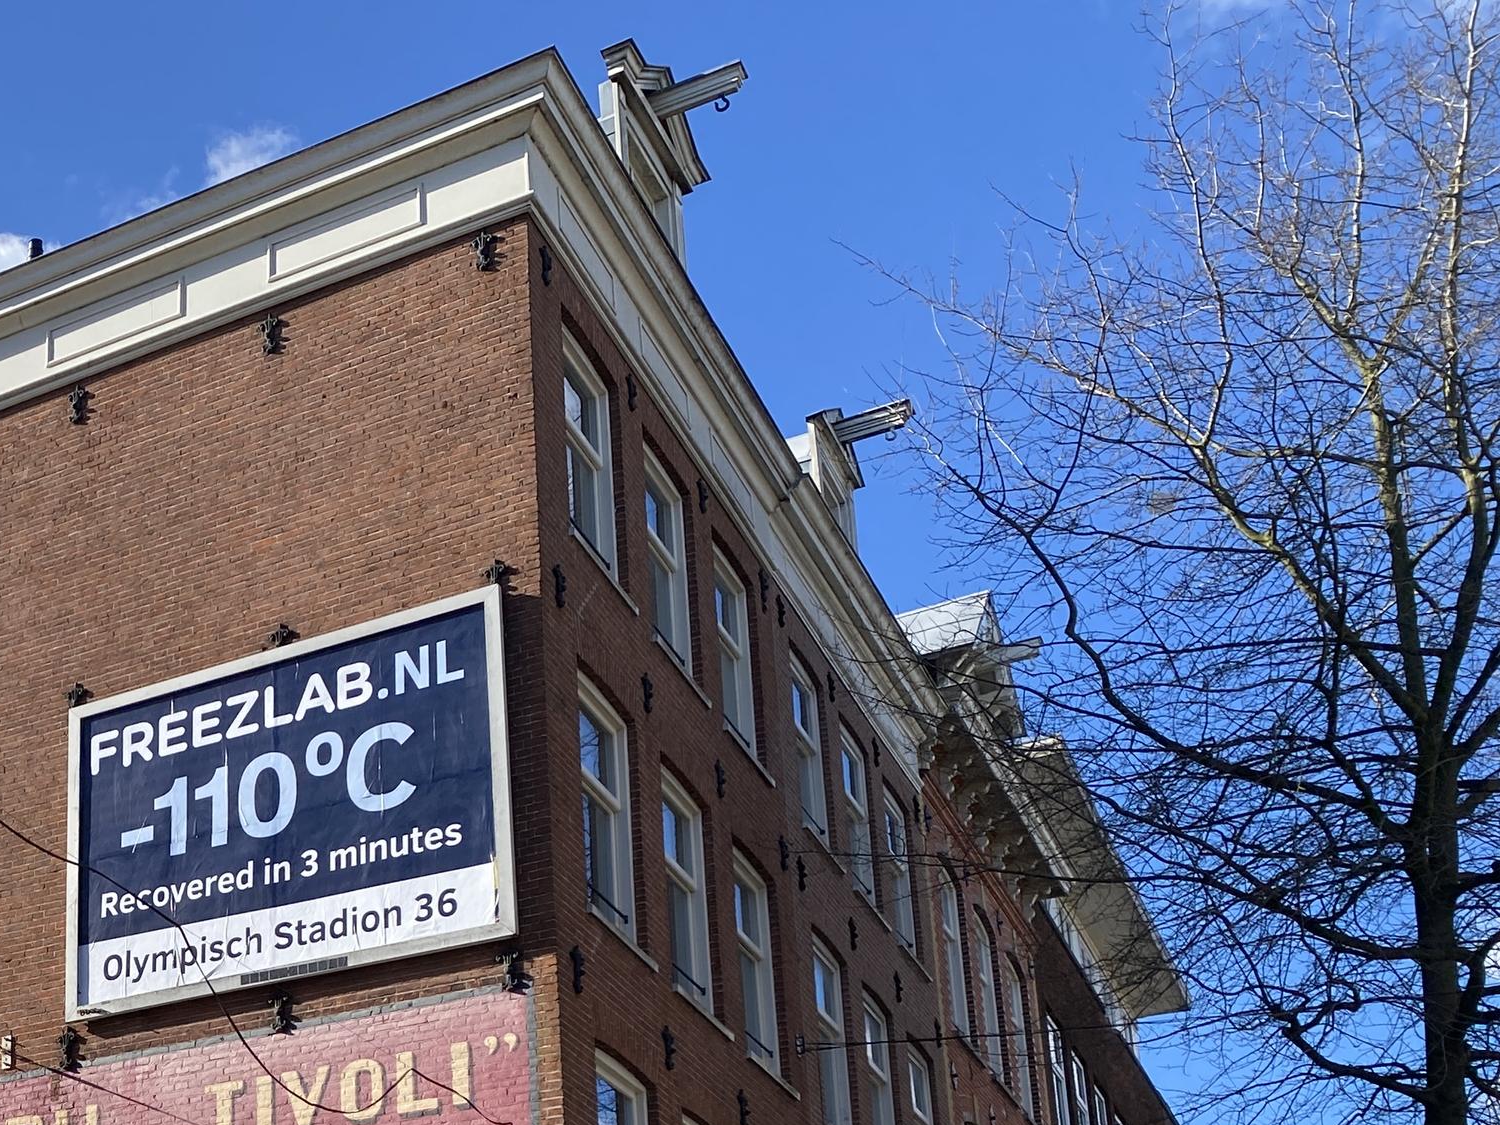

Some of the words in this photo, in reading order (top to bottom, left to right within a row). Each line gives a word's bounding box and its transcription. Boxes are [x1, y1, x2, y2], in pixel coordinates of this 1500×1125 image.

[90, 640, 465, 776] FREEZLAB.NL
[100, 860, 255, 919] Recovered
[263, 852, 291, 886] in
[299, 850, 319, 877] 3
[329, 822, 463, 869] minutes
[102, 927, 263, 983] Olympisch
[274, 900, 402, 951] Stadion
[414, 888, 459, 922] 36
